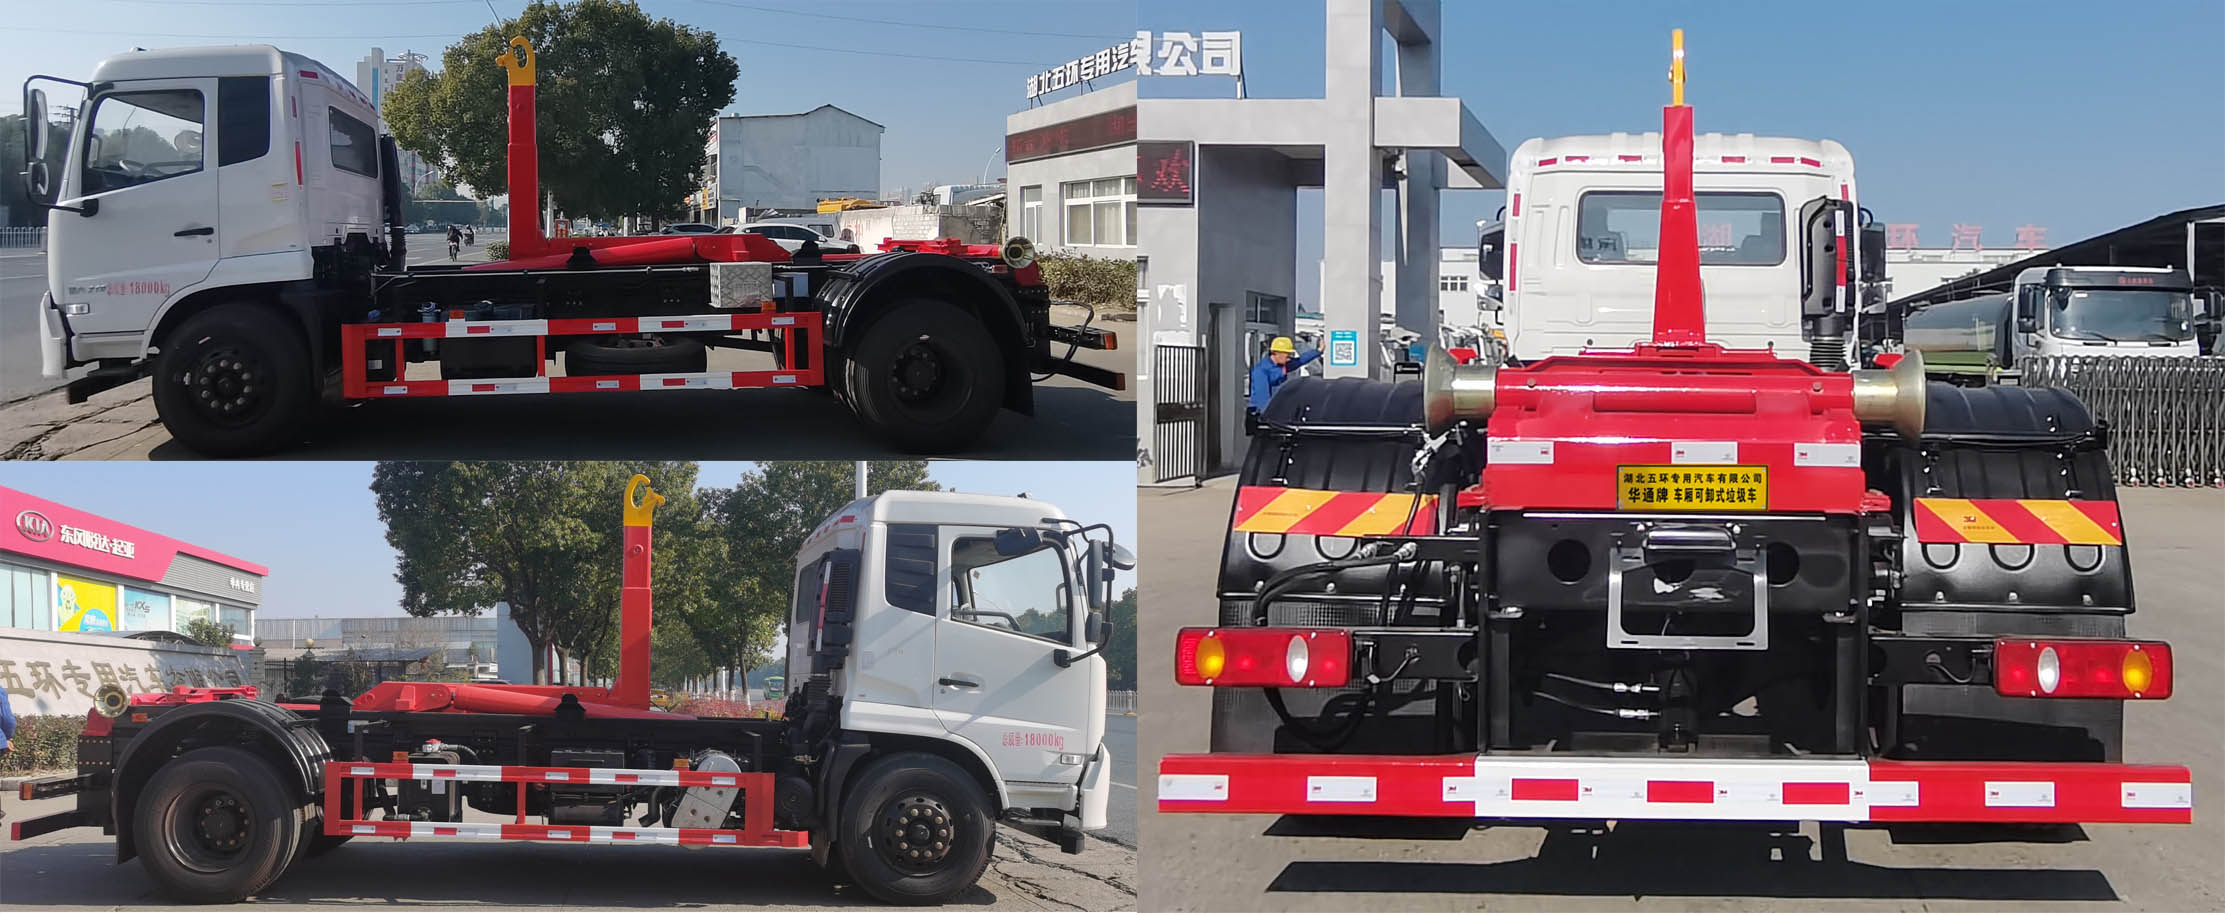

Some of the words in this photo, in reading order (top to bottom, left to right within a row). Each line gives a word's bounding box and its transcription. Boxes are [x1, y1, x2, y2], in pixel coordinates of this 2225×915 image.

[1624, 473, 1762, 484] 湖北五环专用汽车有限公司
[1628, 487, 1669, 503] 华通牌
[1674, 487, 1757, 503] 车厢可卸式垃圾车
[24, 515, 50, 536] KIA
